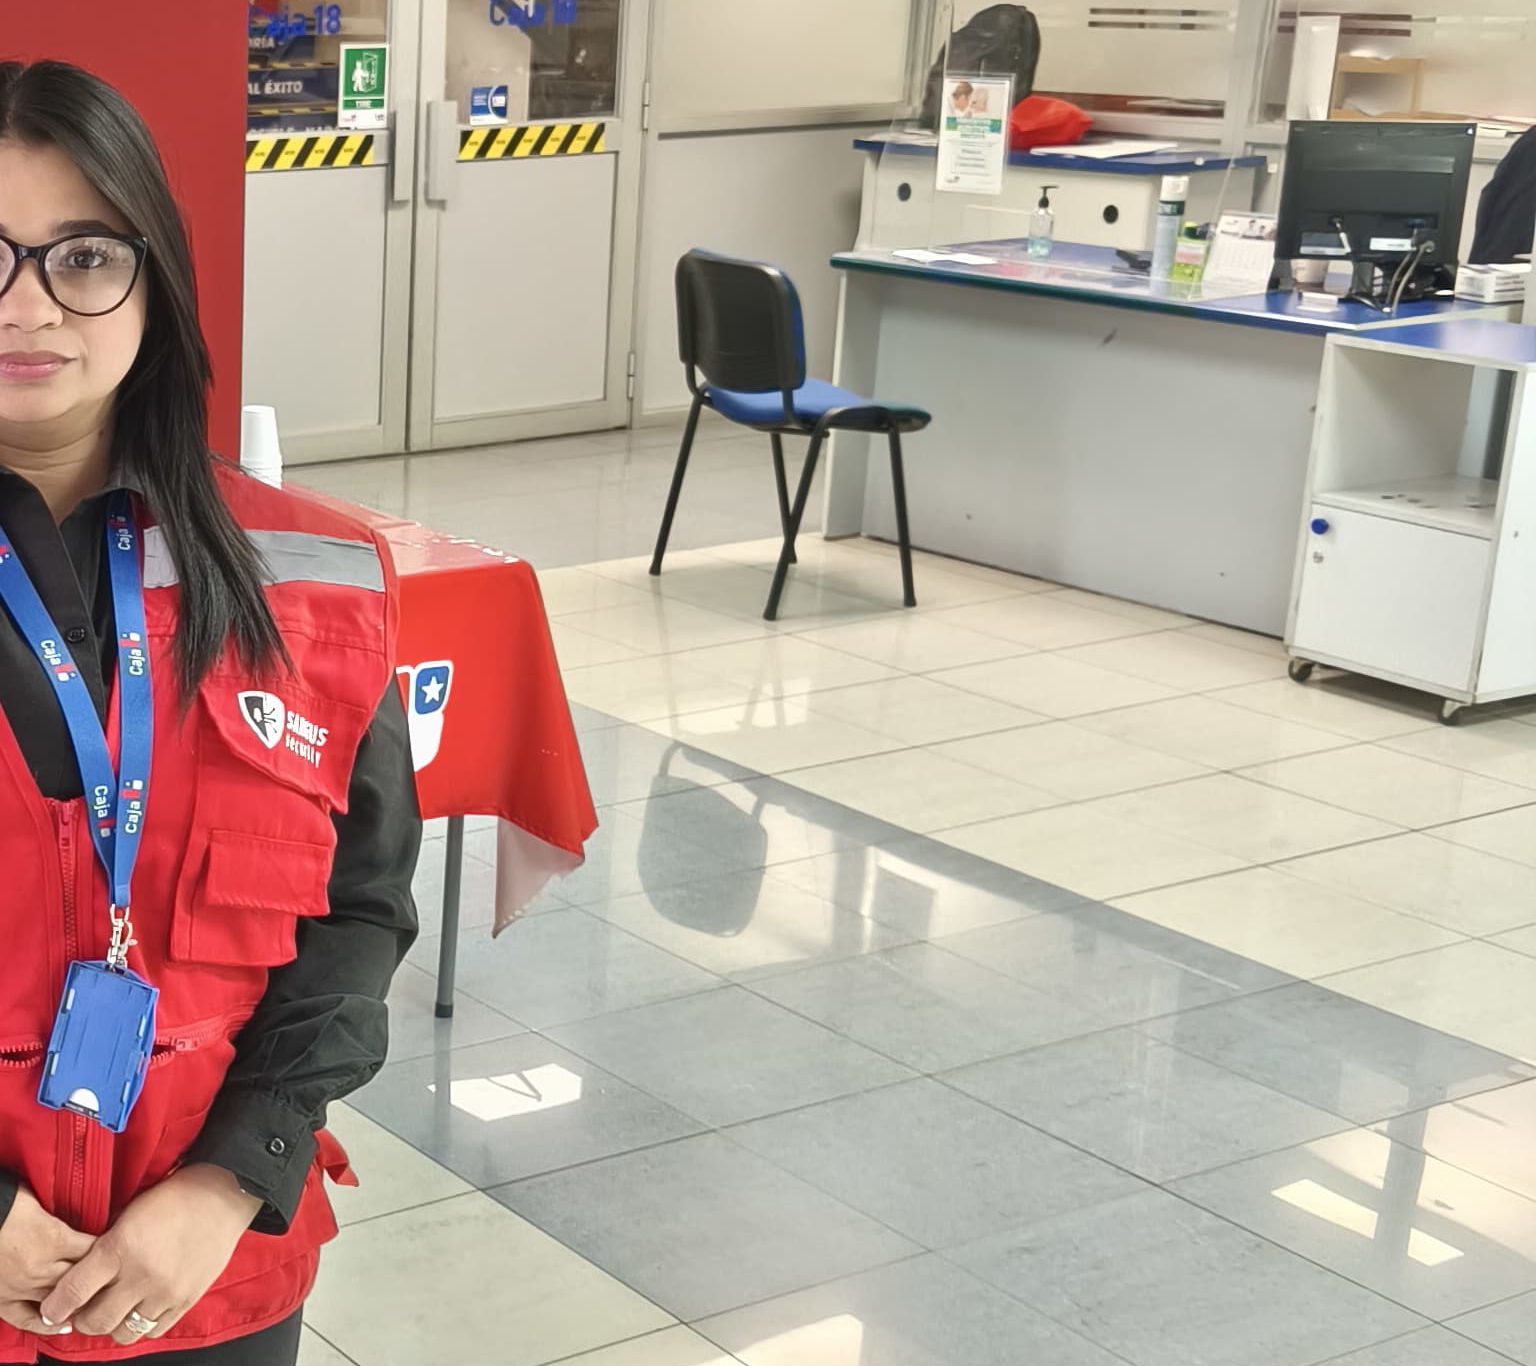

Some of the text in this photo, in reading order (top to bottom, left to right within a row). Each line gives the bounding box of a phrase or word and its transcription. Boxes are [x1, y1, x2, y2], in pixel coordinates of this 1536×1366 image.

[314, 4, 342, 34] 18
[264, 79, 304, 94] ÉXITO
[116, 528, 133, 551] Caja
[40, 639, 62, 666] Caja
[128, 649, 146, 676] Caja
[93, 785, 111, 819] Caja
[125, 800, 142, 834] Caja
